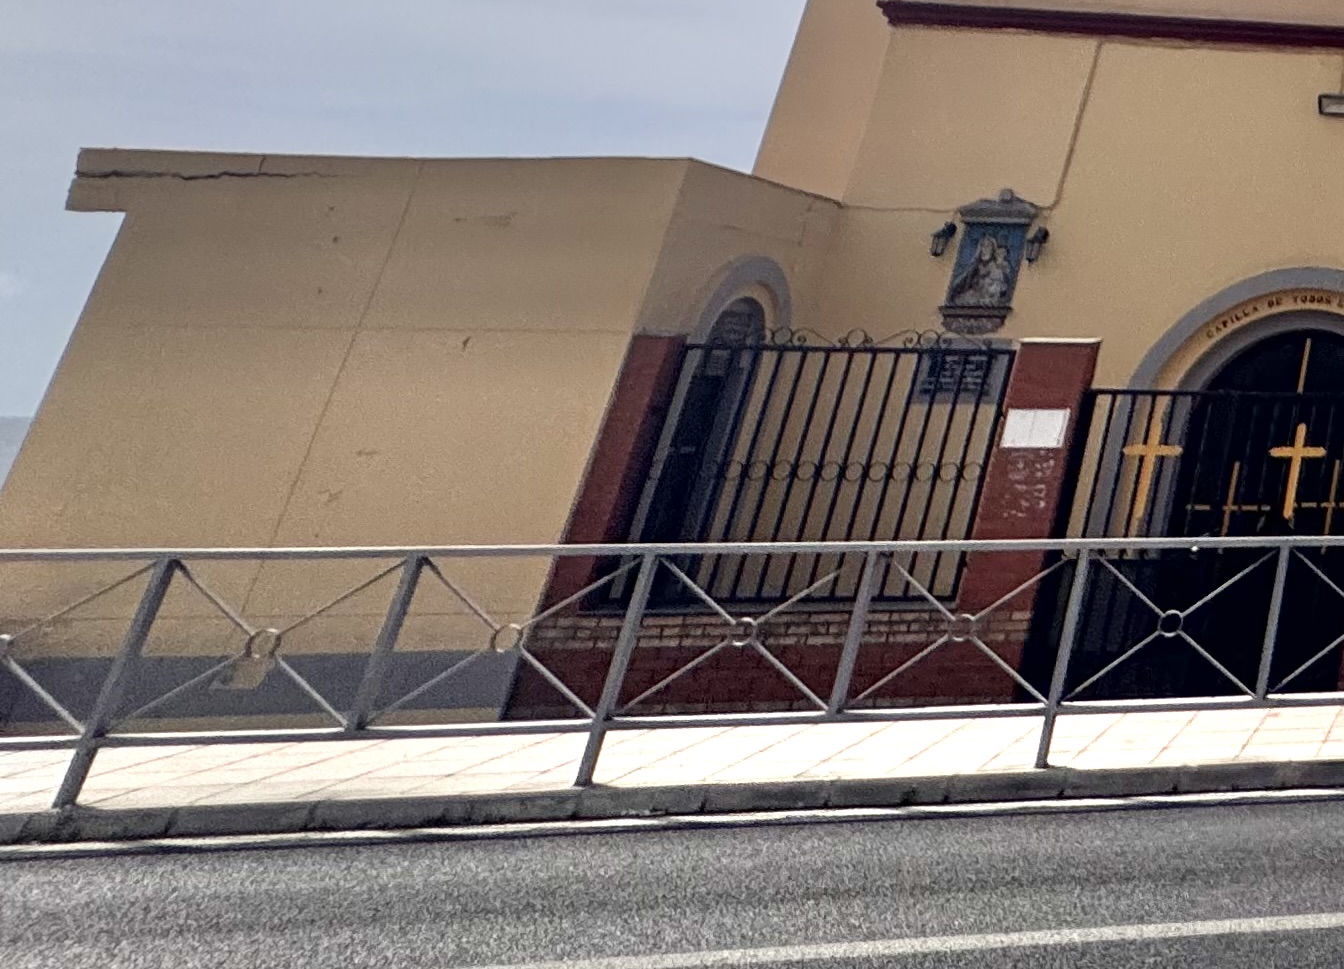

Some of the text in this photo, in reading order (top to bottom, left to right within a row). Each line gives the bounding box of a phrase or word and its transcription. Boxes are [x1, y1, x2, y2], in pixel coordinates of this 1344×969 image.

[1206, 306, 1259, 339] CAPILLA
[1267, 296, 1282, 308] DE
[1293, 294, 1332, 305] TODOS
